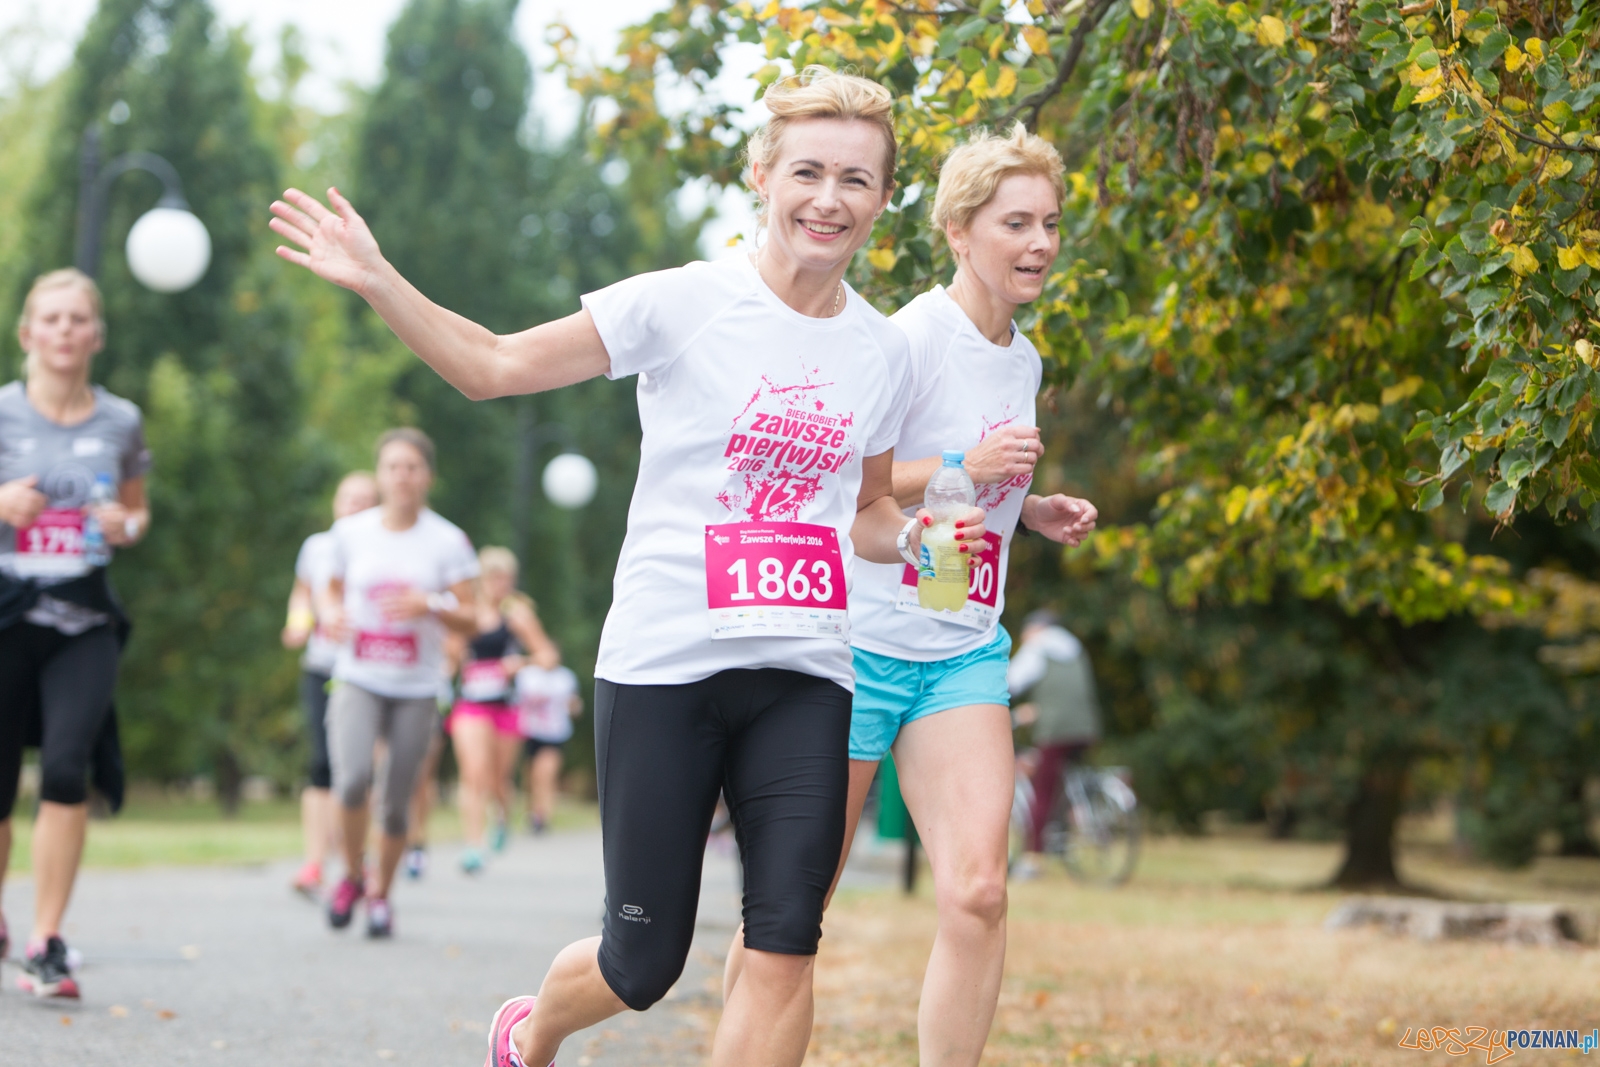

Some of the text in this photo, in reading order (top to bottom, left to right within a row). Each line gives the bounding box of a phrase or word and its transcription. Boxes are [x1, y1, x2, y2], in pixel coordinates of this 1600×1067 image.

[750, 412, 846, 449] zawsze
[786, 408, 838, 427] BIEG KOBIET
[727, 456, 766, 473] 2016
[759, 477, 808, 514] 15
[740, 535, 774, 545] Zawsze
[775, 534, 806, 546] Pier(w)si
[806, 536, 823, 547] 2016
[727, 557, 833, 603] 1863
